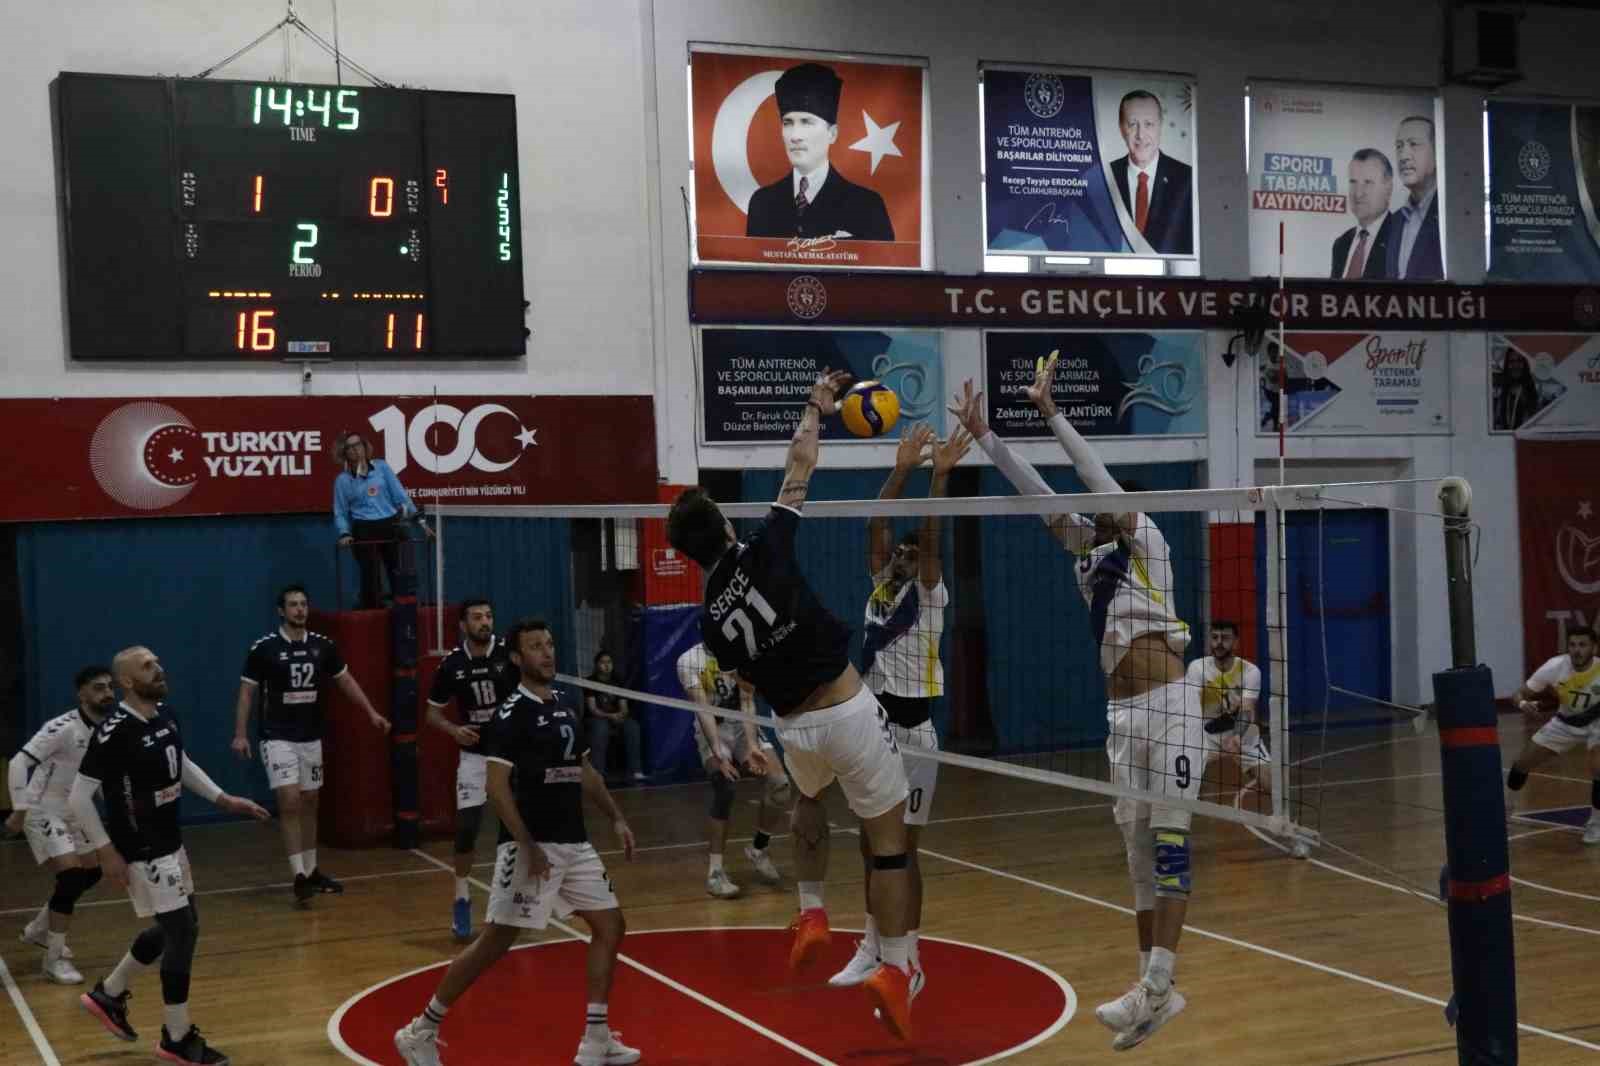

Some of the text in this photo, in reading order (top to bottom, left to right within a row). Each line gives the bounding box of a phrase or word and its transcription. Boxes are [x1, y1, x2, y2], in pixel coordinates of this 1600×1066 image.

[253, 87, 360, 130] 14:45
[289, 127, 318, 142] TIME
[1031, 126, 1082, 139] ANTRENÖR
[996, 136, 1093, 152] VE SPORCULARIMIZA
[996, 150, 1092, 163] BAŞARILAR DİLİYORUM
[1271, 155, 1323, 174] SPORU
[1265, 174, 1331, 192] TABANA
[369, 176, 394, 217] 0
[1255, 192, 1345, 212] YAYIYORUZ
[292, 223, 318, 264] 2
[288, 263, 322, 278] PERIOD
[944, 287, 1007, 314] T.C.
[1020, 286, 1168, 319] GENÇLİK
[1177, 291, 1217, 316] VE
[1320, 290, 1486, 319] BAKANLIĞI
[238, 310, 276, 350] 16
[730, 357, 816, 370] TÜM ANTRENÖR
[1011, 357, 1034, 369] TÜM
[717, 371, 732, 382] VE
[999, 370, 1100, 381] VE SPOLARIMIZA
[717, 385, 773, 396] BAŞARILAR
[757, 411, 781, 421] Faruk
[995, 407, 1039, 421] Zekeriya
[723, 421, 752, 432] Düzce
[753, 421, 791, 433] Belediye
[709, 567, 750, 621] SERÇE
[721, 585, 777, 661] 21
[289, 662, 315, 689] 52
[559, 723, 577, 760] 2
[1175, 754, 1191, 790] 9
